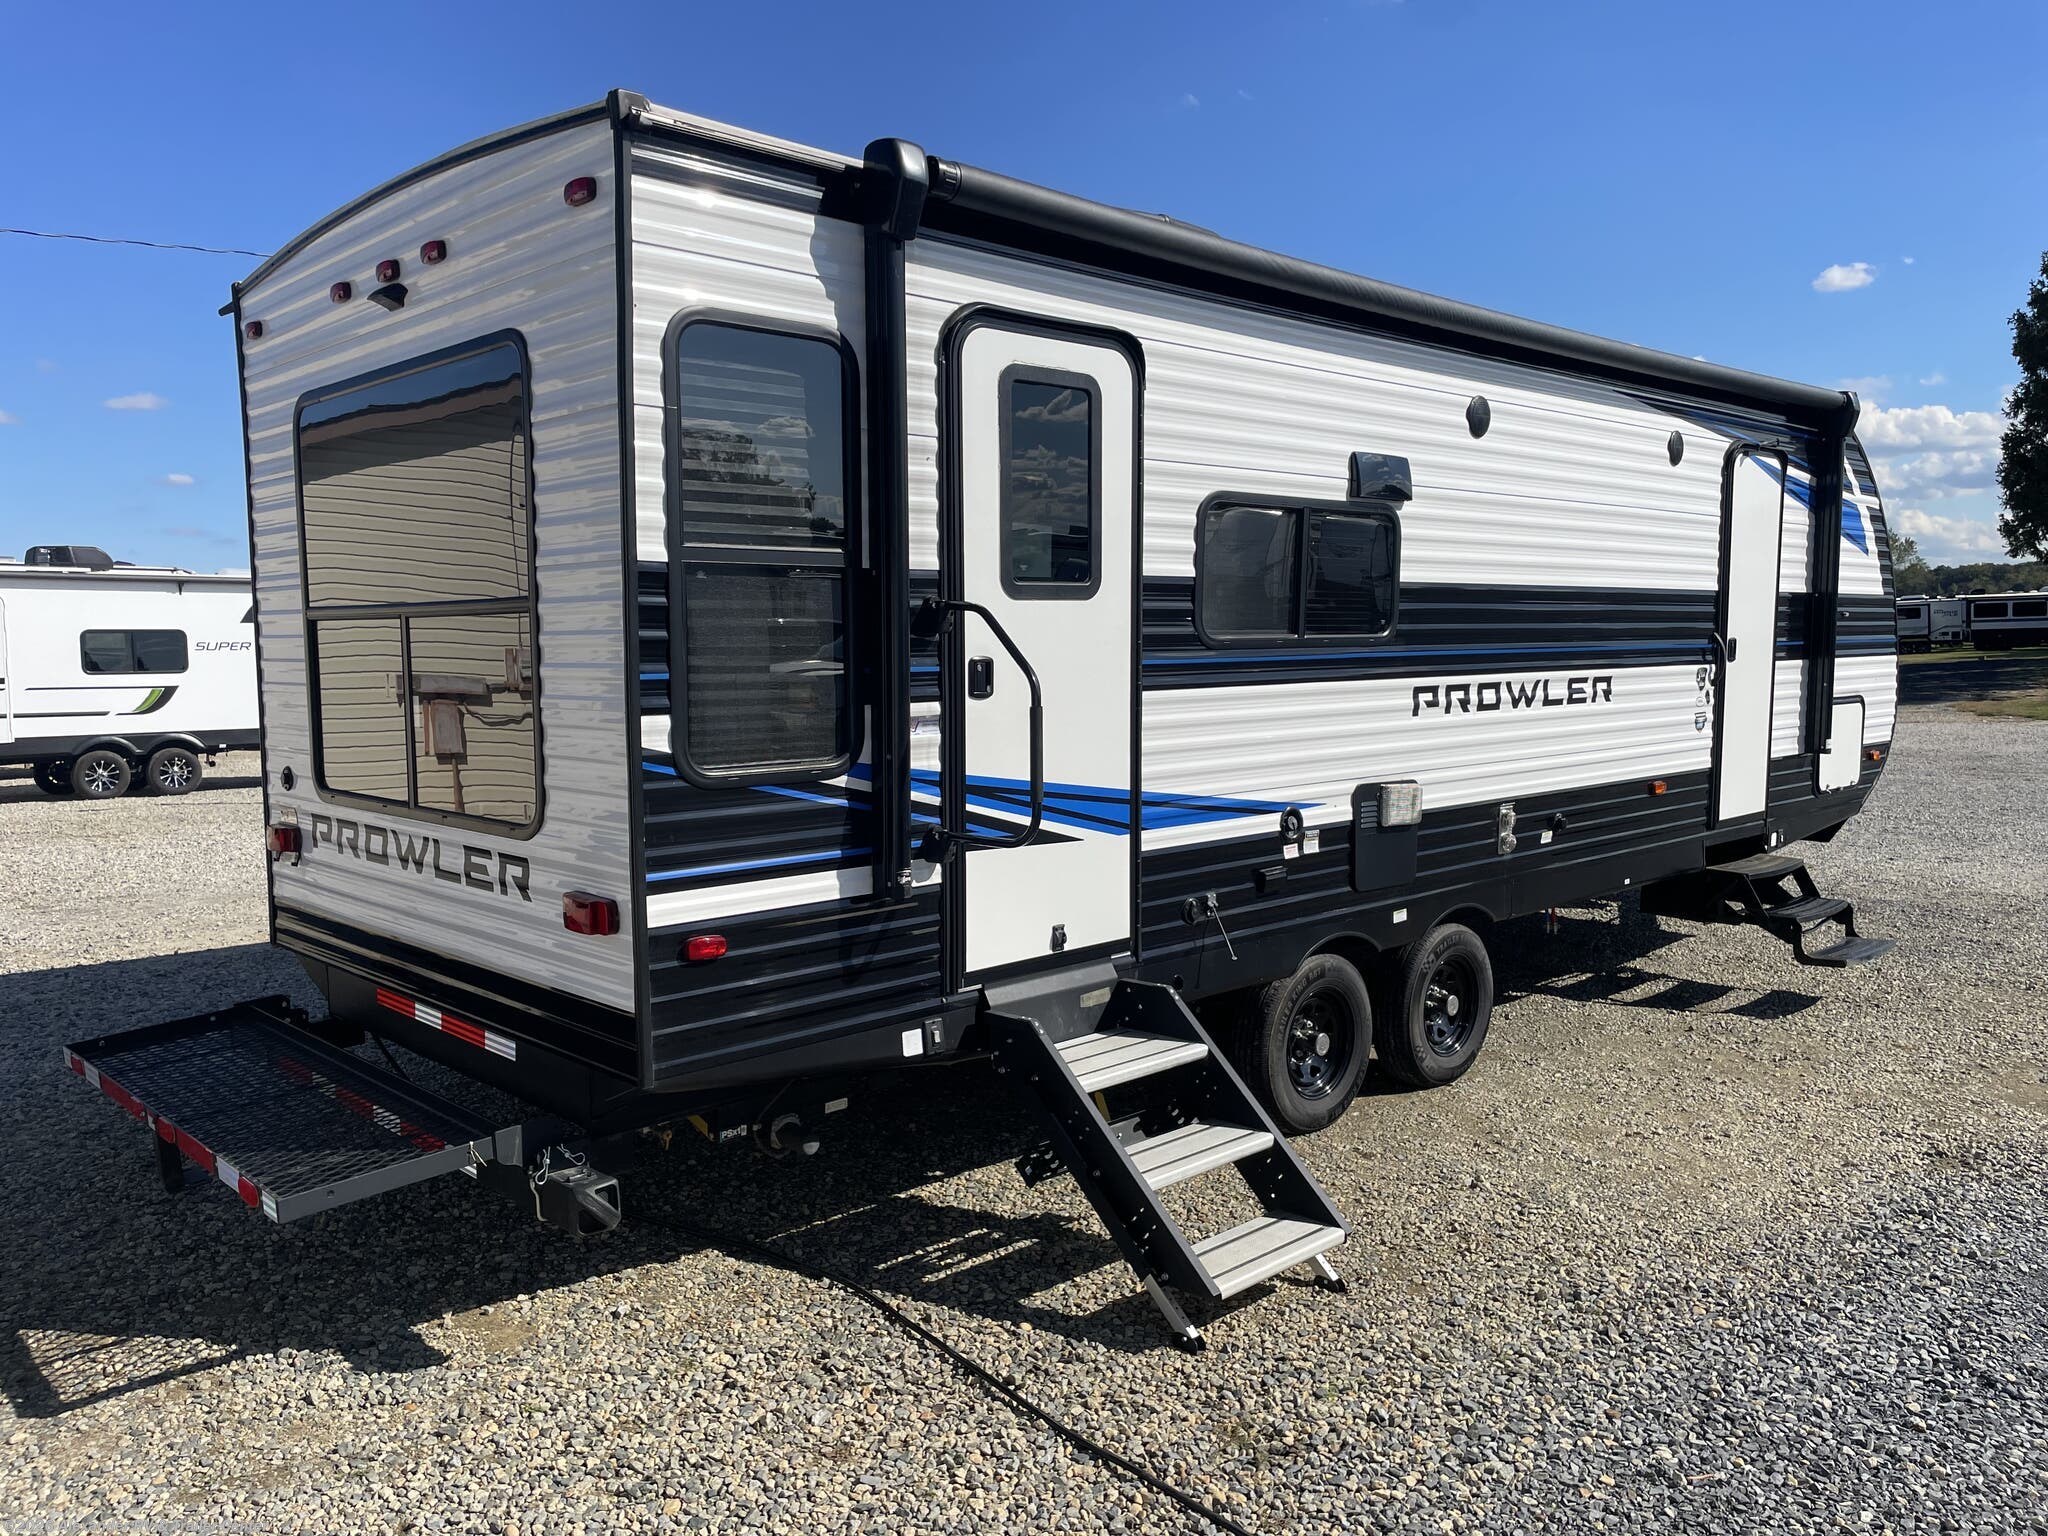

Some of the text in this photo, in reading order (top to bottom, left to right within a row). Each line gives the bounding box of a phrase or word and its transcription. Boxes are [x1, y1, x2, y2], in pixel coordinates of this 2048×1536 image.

[194, 641, 252, 652] SUPER
[1411, 675, 1613, 717] PROWLER
[311, 812, 533, 903] PROWLER
